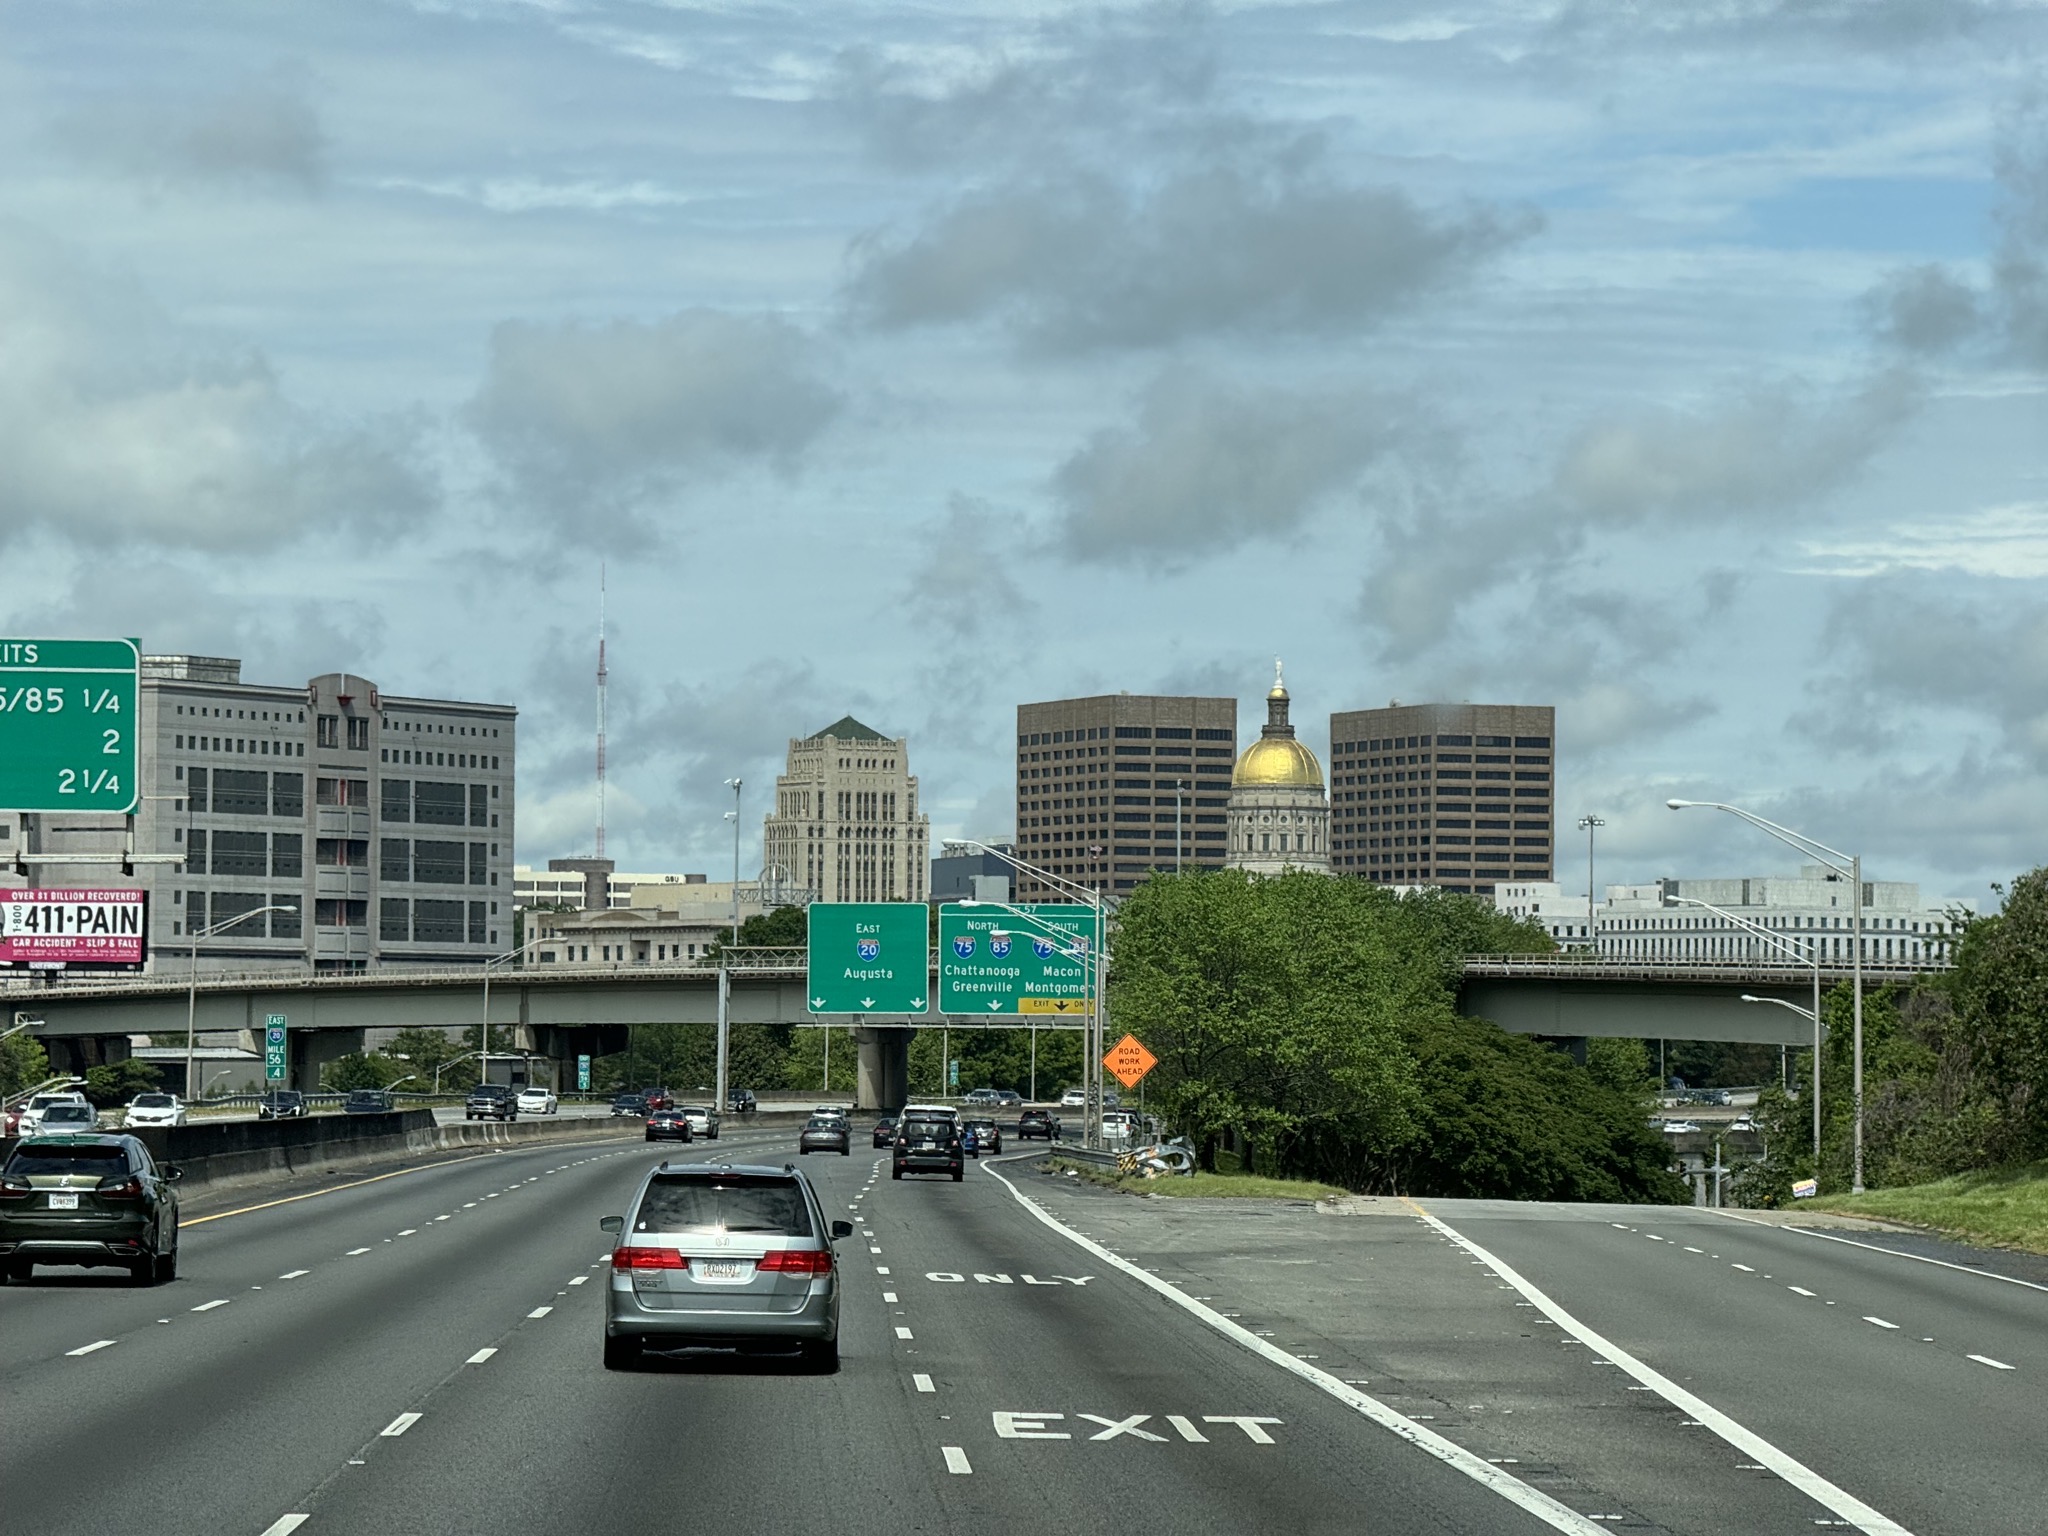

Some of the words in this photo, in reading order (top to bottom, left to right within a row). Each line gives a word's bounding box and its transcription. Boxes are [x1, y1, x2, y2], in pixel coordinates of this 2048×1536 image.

[0, 644, 39, 663] ITS
[83, 688, 120, 713] 1/4
[102, 729, 120, 754] 2
[12, 891, 34, 900] OVER
[38, 891, 48, 901] $1
[51, 892, 85, 901] BILLION
[87, 892, 140, 901] RECOVERED!
[1024, 905, 1037, 914] 57
[856, 923, 880, 933] EAST
[967, 921, 999, 931] NORTH
[1047, 921, 1079, 932] SOUTH
[13, 938, 31, 947] CAR
[34, 939, 77, 947] ACCIDENT
[86, 939, 106, 948] SLIP
[118, 940, 138, 948] FALL
[957, 943, 972, 953] 75
[992, 943, 1009, 953] 85
[861, 945, 877, 956] 20
[843, 968, 893, 981] Augusta
[945, 965, 1020, 978] Chattanooga
[1043, 966, 1081, 977] Macon
[952, 981, 1013, 993] Greenville
[268, 1016, 284, 1025] EAST
[267, 1045, 285, 1053] MILE
[269, 1054, 281, 1064] 56
[925, 1272, 1096, 1286] ONLY
[992, 1411, 1286, 1444] EXIT
